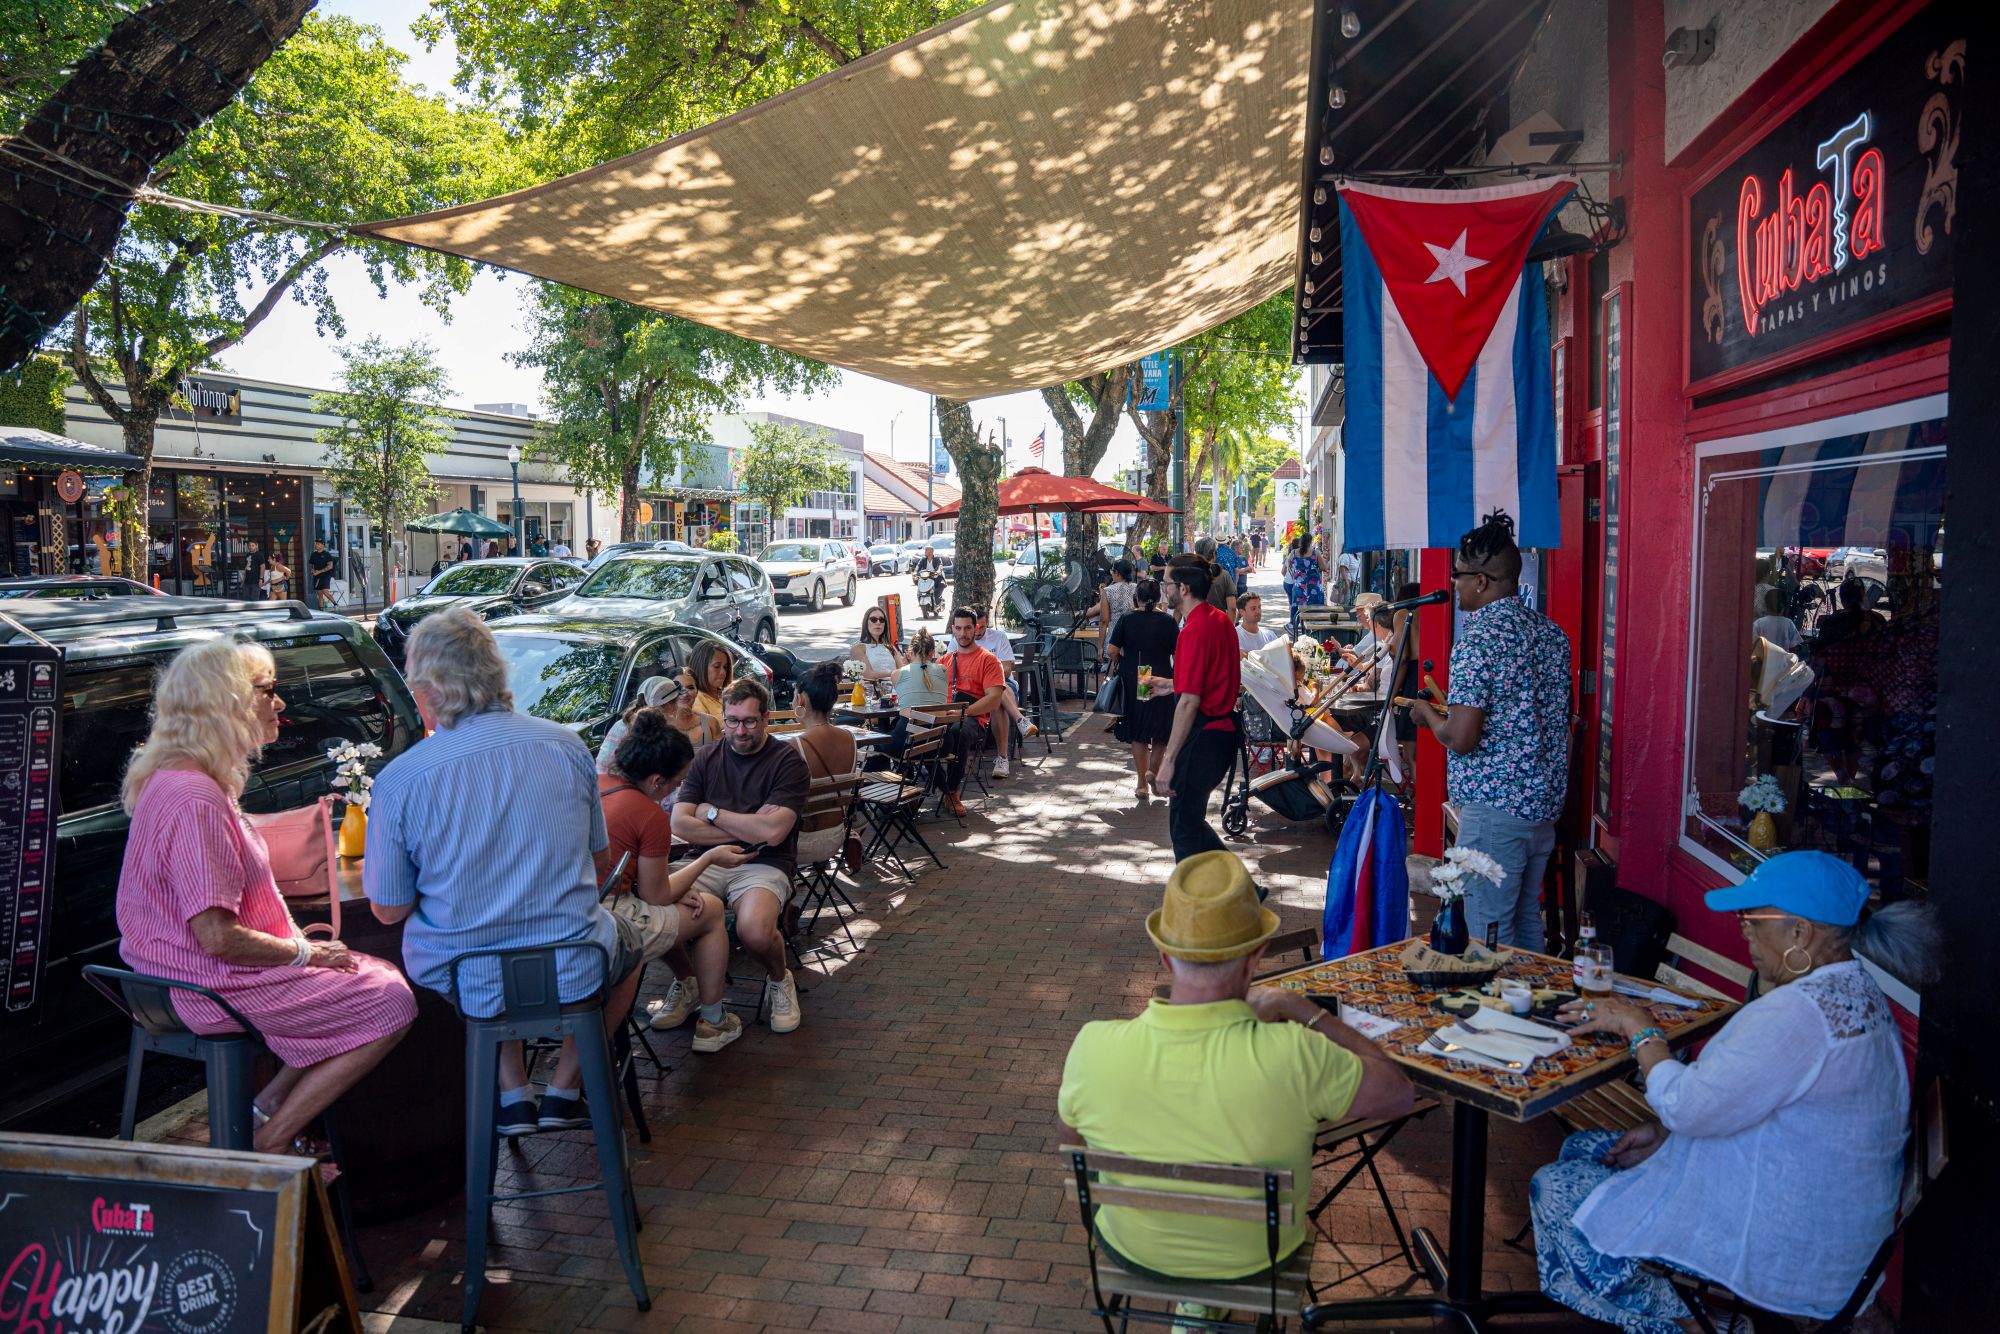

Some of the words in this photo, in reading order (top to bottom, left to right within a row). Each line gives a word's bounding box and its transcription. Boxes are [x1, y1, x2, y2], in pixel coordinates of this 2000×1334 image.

[1738, 109, 1885, 336] CubaTa
[1761, 301, 1804, 334] TAPAS
[1812, 294, 1821, 313] Y
[1829, 264, 1887, 305] VINOS
[92, 1197, 154, 1233] CubaTa
[184, 1256, 198, 1266] AND
[0, 1242, 159, 1334] Happy
[176, 1273, 214, 1299] BEST
[179, 1289, 220, 1314] DRINK
